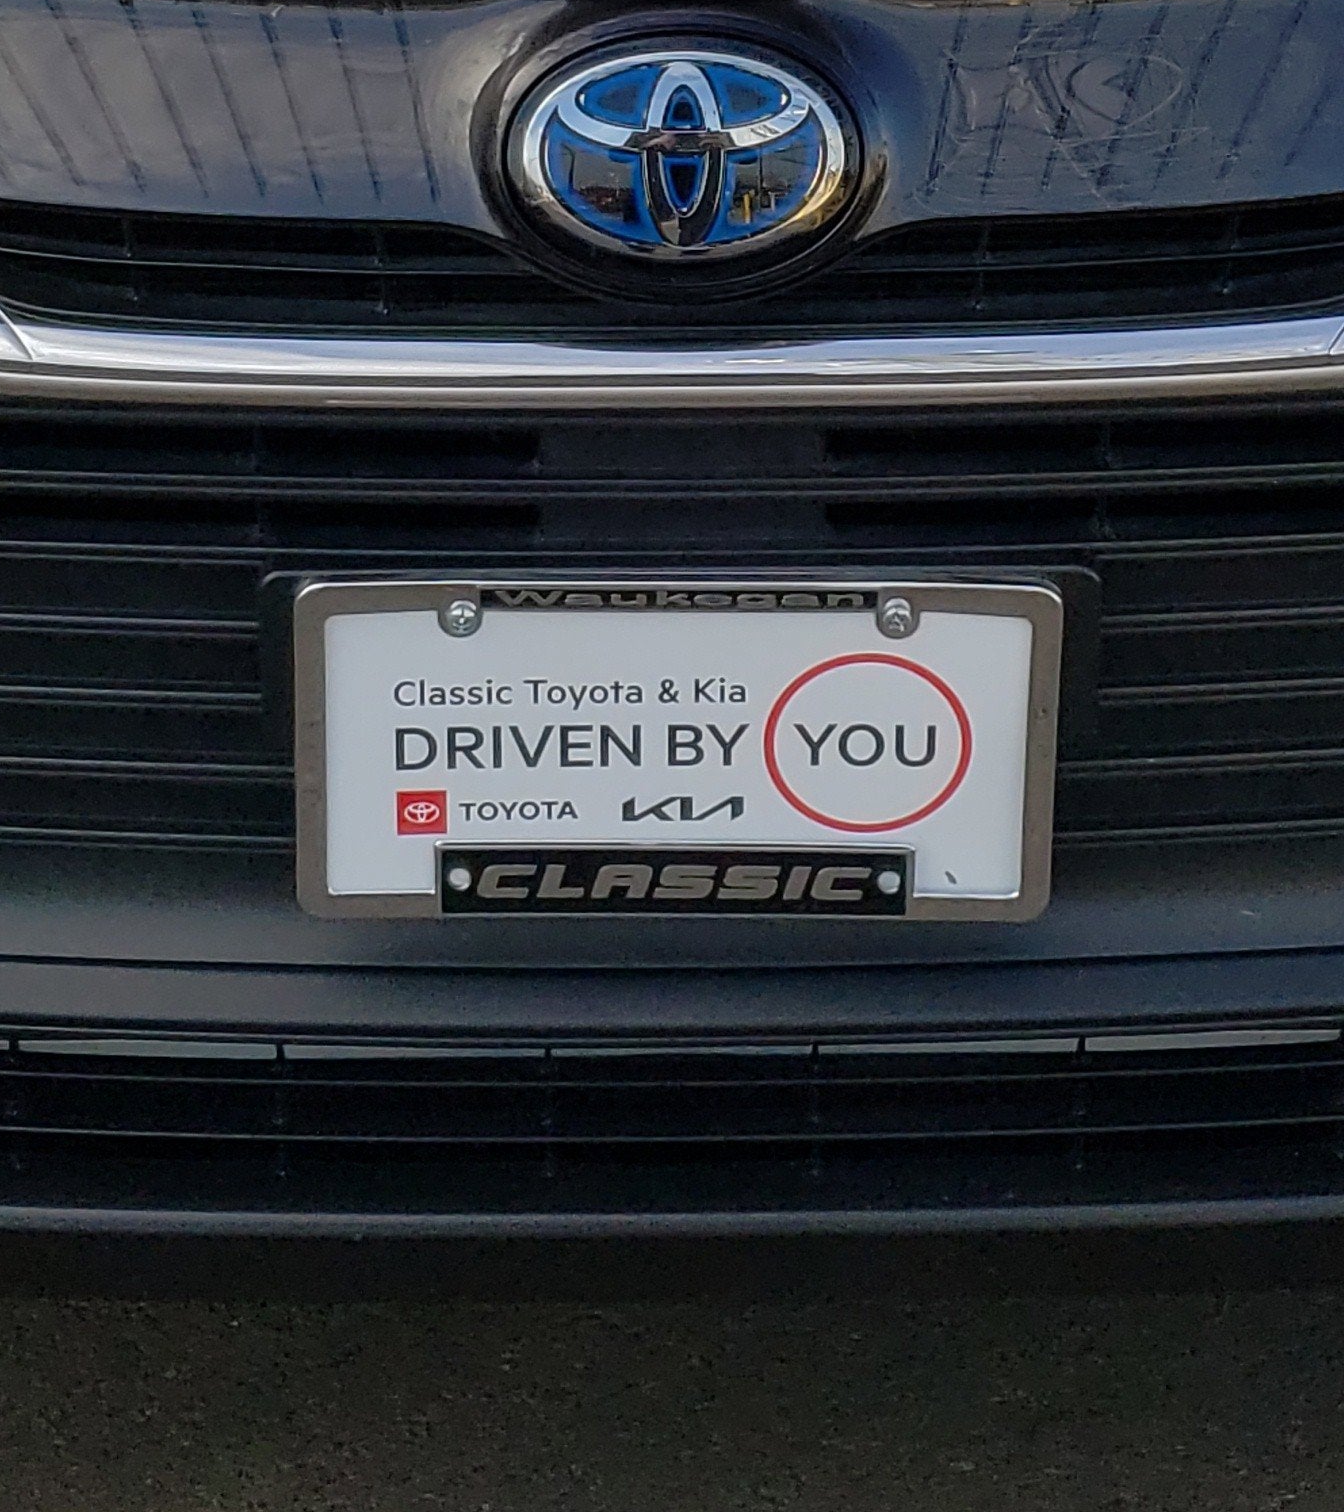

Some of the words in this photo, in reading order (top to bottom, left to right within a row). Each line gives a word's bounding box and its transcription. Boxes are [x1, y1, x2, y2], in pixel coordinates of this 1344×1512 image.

[394, 679, 513, 706] Classic
[523, 678, 643, 709] Toyota
[658, 678, 680, 704] &
[694, 678, 747, 703] Kia
[395, 724, 642, 771] DRIVEN
[667, 723, 750, 767] BY
[793, 724, 938, 766] YOU
[459, 801, 578, 822] TOYOTA
[476, 863, 872, 902] CLASSIC
